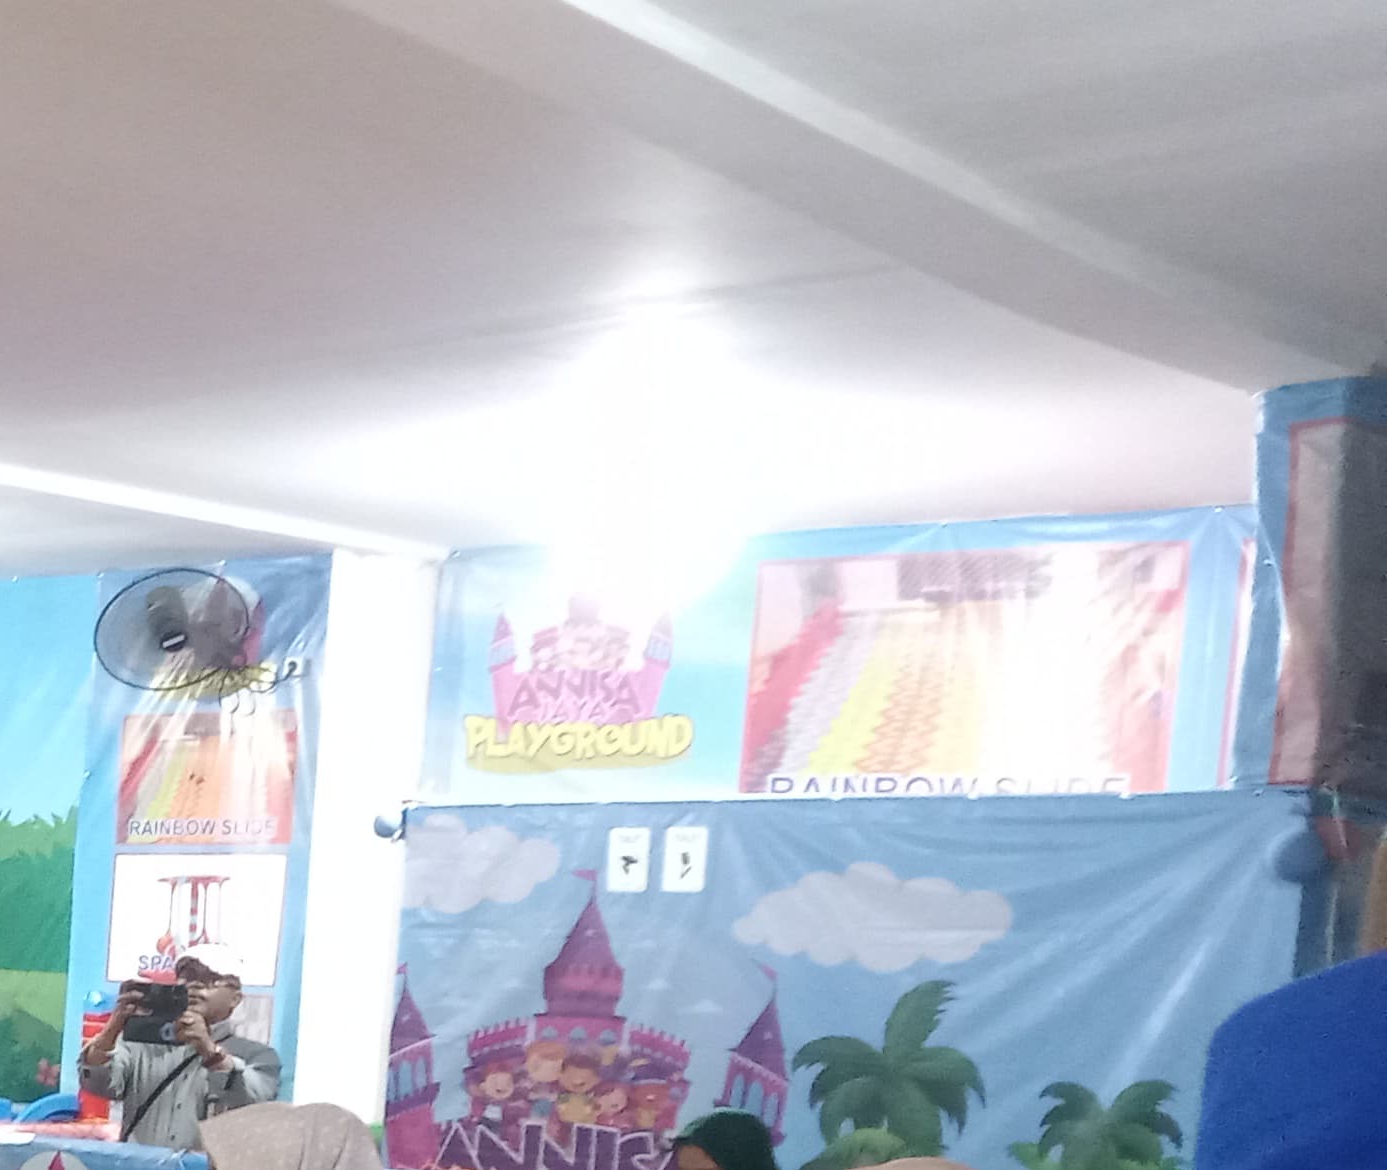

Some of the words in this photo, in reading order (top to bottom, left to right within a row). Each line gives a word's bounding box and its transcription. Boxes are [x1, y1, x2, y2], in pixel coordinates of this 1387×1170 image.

[508, 669, 641, 716] ANNISA
[464, 714, 694, 760] PLAYGROUND
[129, 819, 216, 836] RAINBOW
